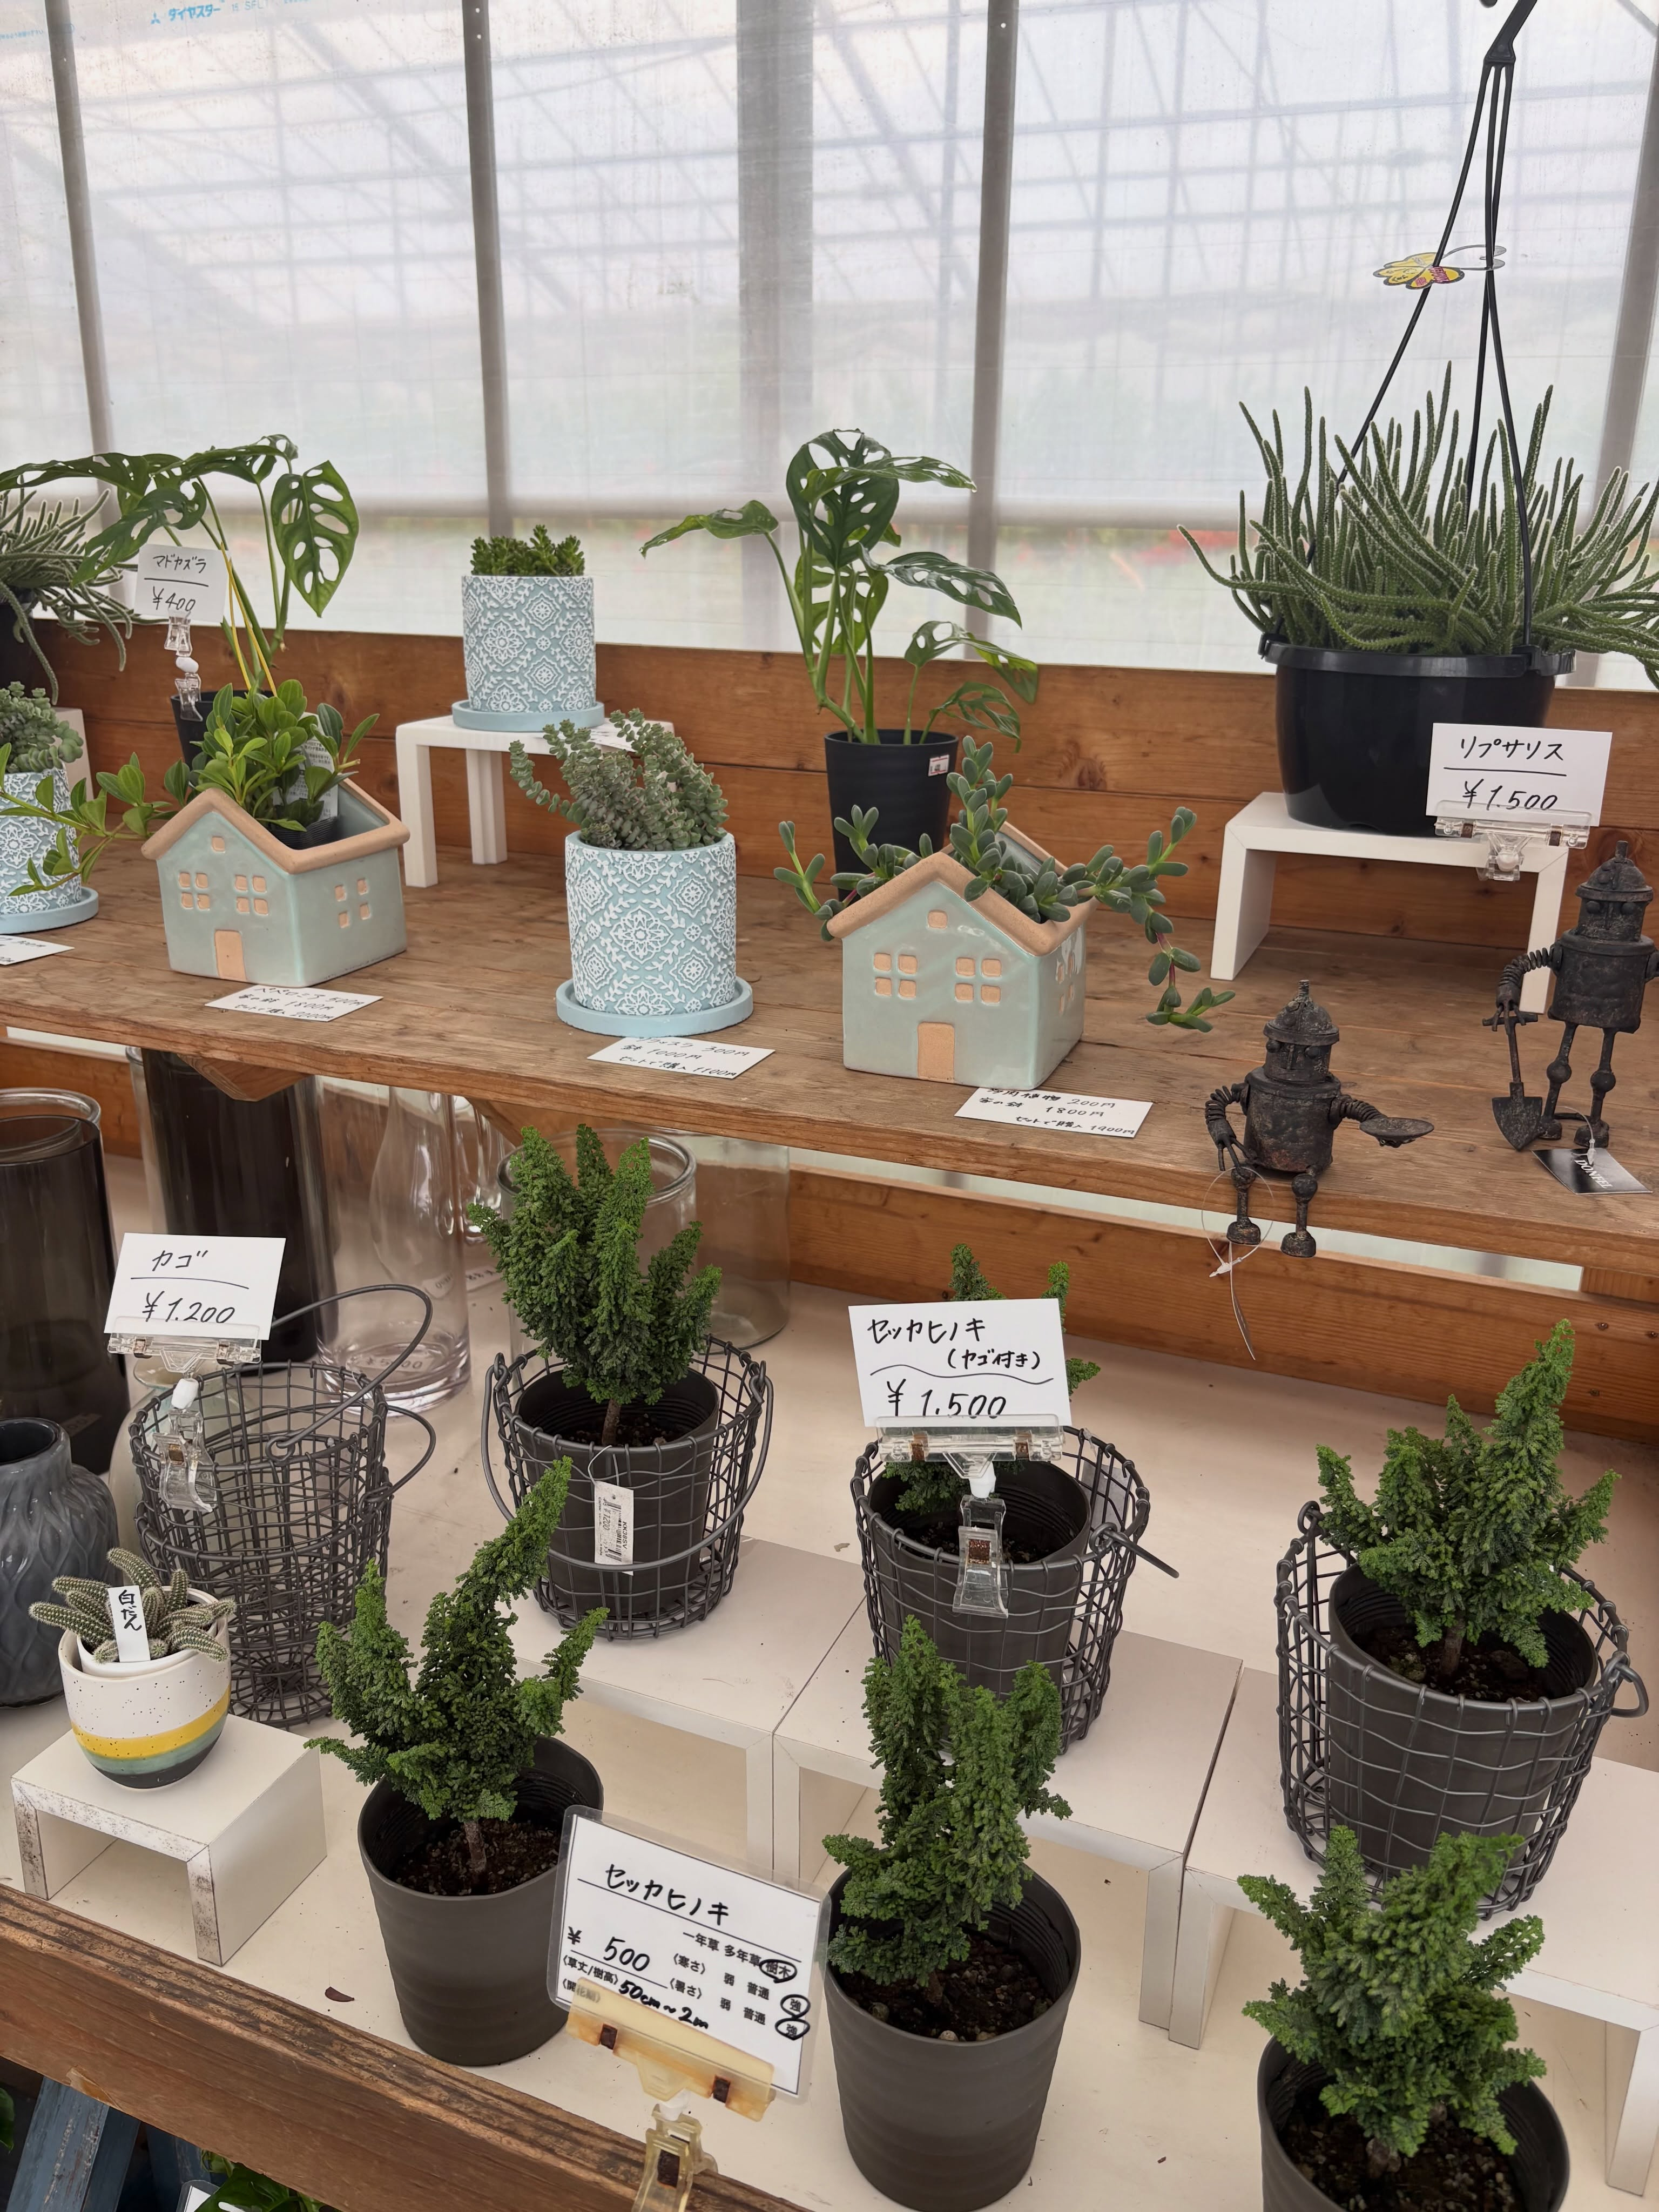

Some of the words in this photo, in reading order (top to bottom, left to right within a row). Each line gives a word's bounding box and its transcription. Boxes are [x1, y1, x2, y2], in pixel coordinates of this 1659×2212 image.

[168, 4, 221, 22] ダイヤスター
[153, 554, 206, 573] マドカズラ
[152, 586, 195, 612] ¥400
[1461, 736, 1563, 761] リプサリス
[647, 1049, 702, 1060] 1000円
[702, 1046, 750, 1056] 300円
[693, 1067, 737, 1076] 1100円
[979, 1097, 1024, 1108] 家の鉢
[1046, 1106, 1104, 1117] 1800円
[987, 1088, 1061, 1101] 多肉植物
[1067, 1098, 1116, 1108] 200円
[1090, 1125, 1135, 1135] 1900円
[152, 1250, 208, 1272] カゴ
[867, 1318, 986, 1344] セッカヒノキ
[118, 1589, 142, 1631] 白だん
[605, 1864, 729, 1926] セッカヒノキ
[603, 1937, 650, 1972] 500
[683, 1932, 720, 1951] 一年草
[725, 1945, 762, 1967] 多年草
[765, 1961, 792, 1979] 樹木
[724, 1973, 735, 1986] 弱
[747, 1982, 770, 2000] 普通
[790, 1999, 802, 2013] 強
[720, 1997, 731, 2011] 弱
[744, 2007, 766, 2025] 普通
[785, 2024, 798, 2038] 強
